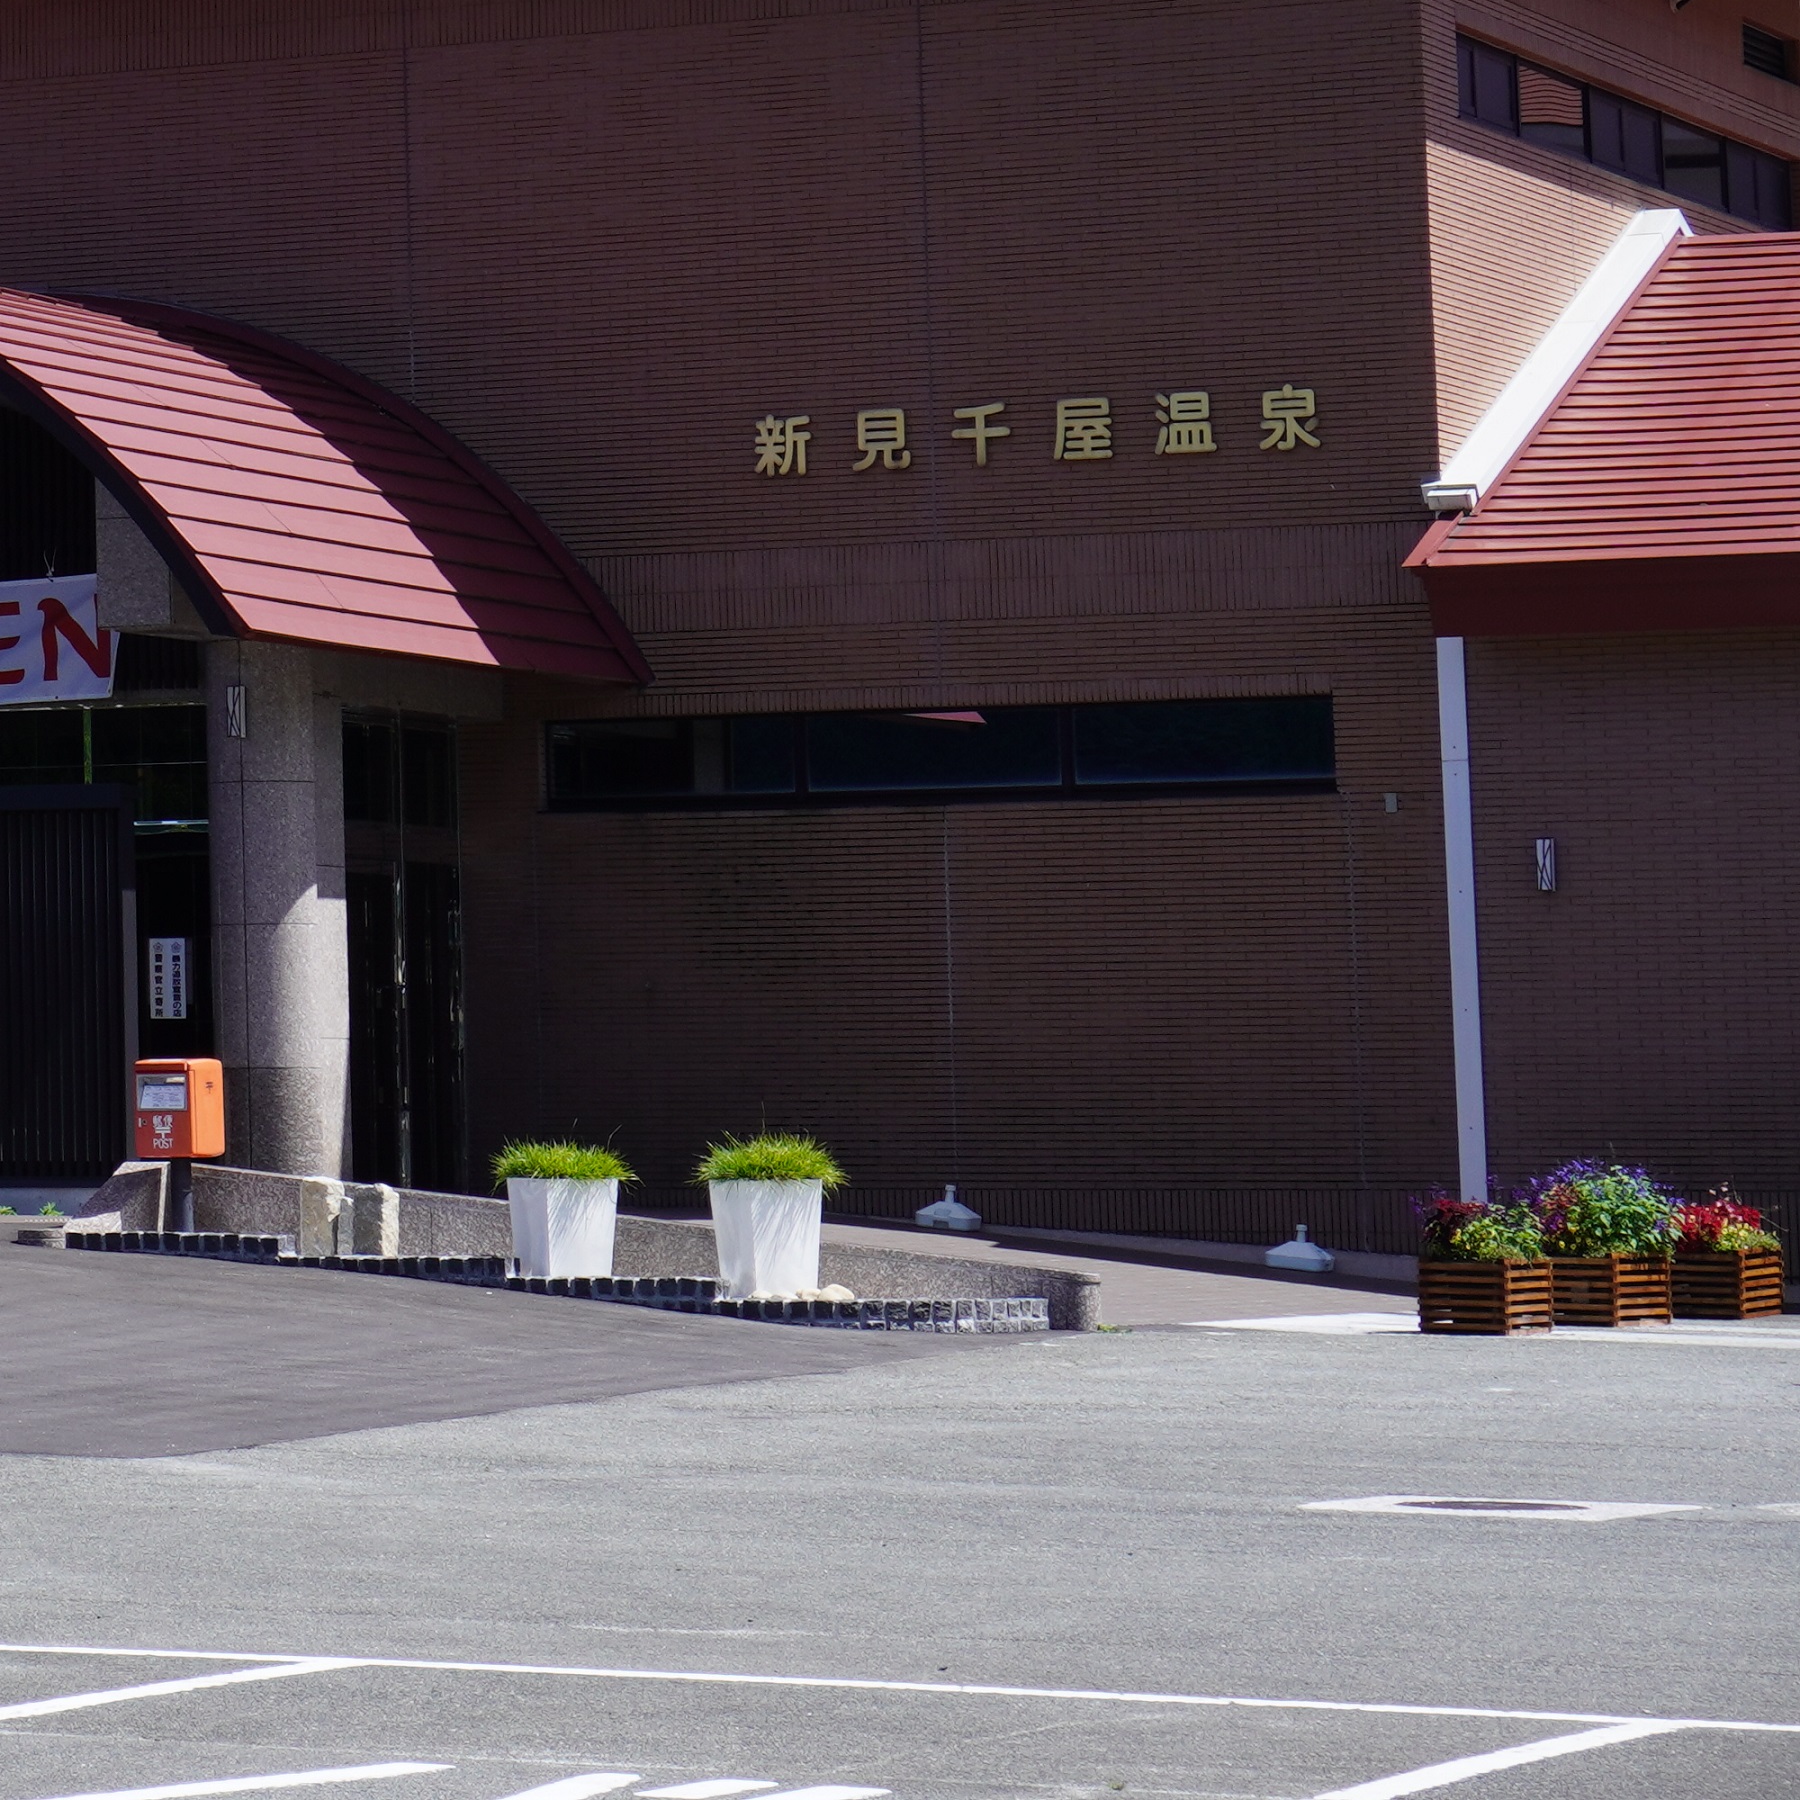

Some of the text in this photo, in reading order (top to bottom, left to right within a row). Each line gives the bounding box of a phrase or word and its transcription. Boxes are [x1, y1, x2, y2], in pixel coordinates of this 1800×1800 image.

[753, 383, 1322, 477] 新見千屋温泉
[153, 1138, 173, 1149] POST
